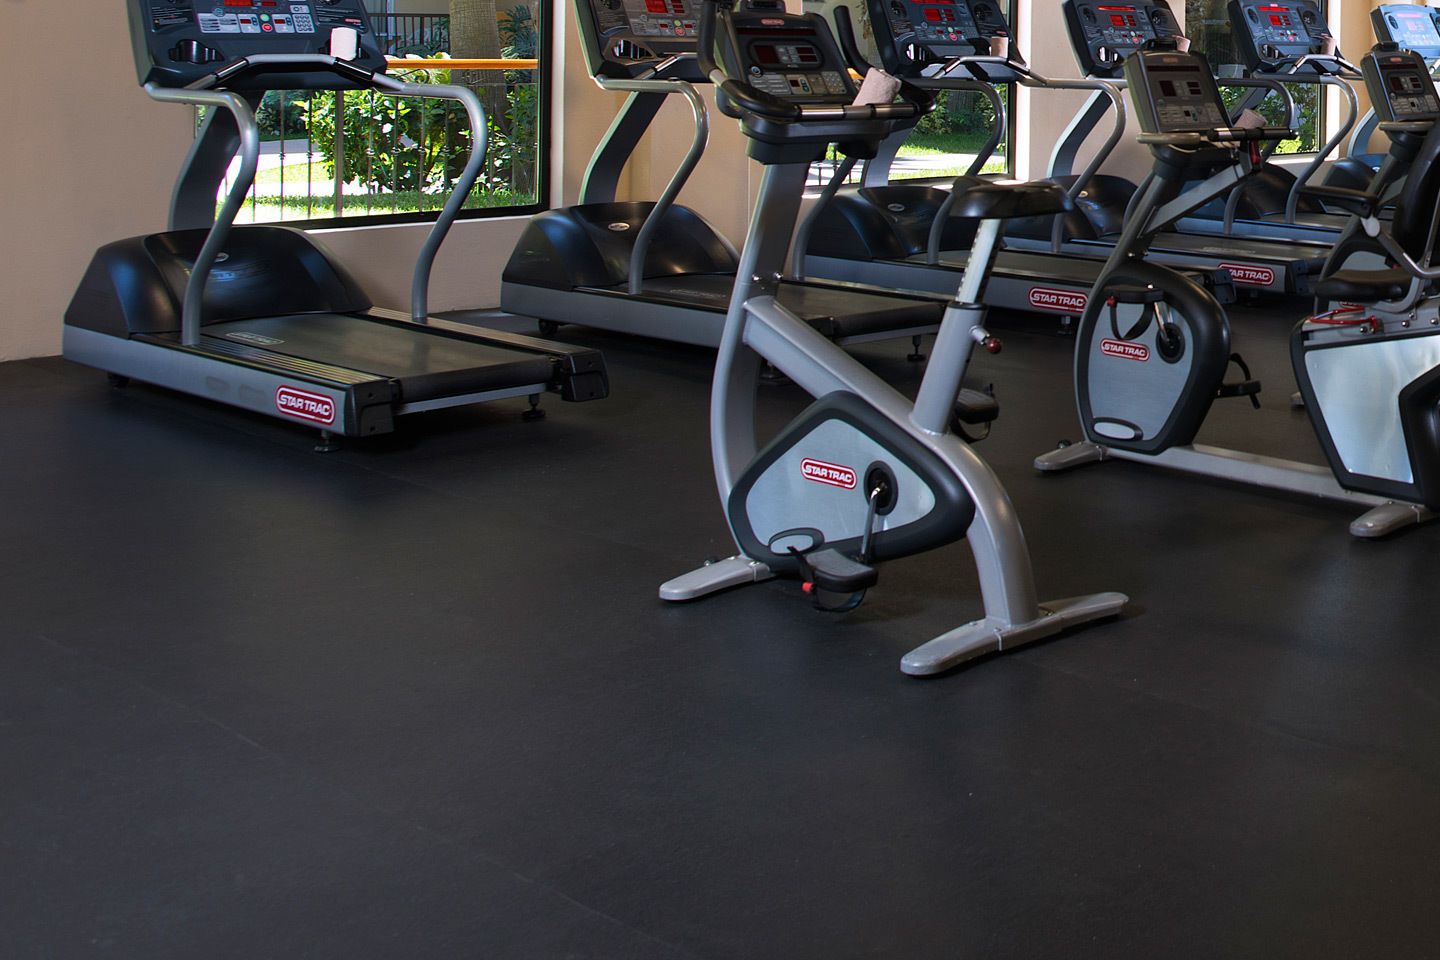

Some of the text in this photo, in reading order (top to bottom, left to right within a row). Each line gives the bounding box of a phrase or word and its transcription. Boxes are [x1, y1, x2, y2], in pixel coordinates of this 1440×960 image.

[1245, 271, 1270, 280] TRAC
[1033, 293, 1085, 307] STAR TRAC
[1104, 343, 1146, 357] STAR TRAC
[278, 395, 331, 416] STAR TRAC
[803, 464, 853, 483] STAR TRAC
